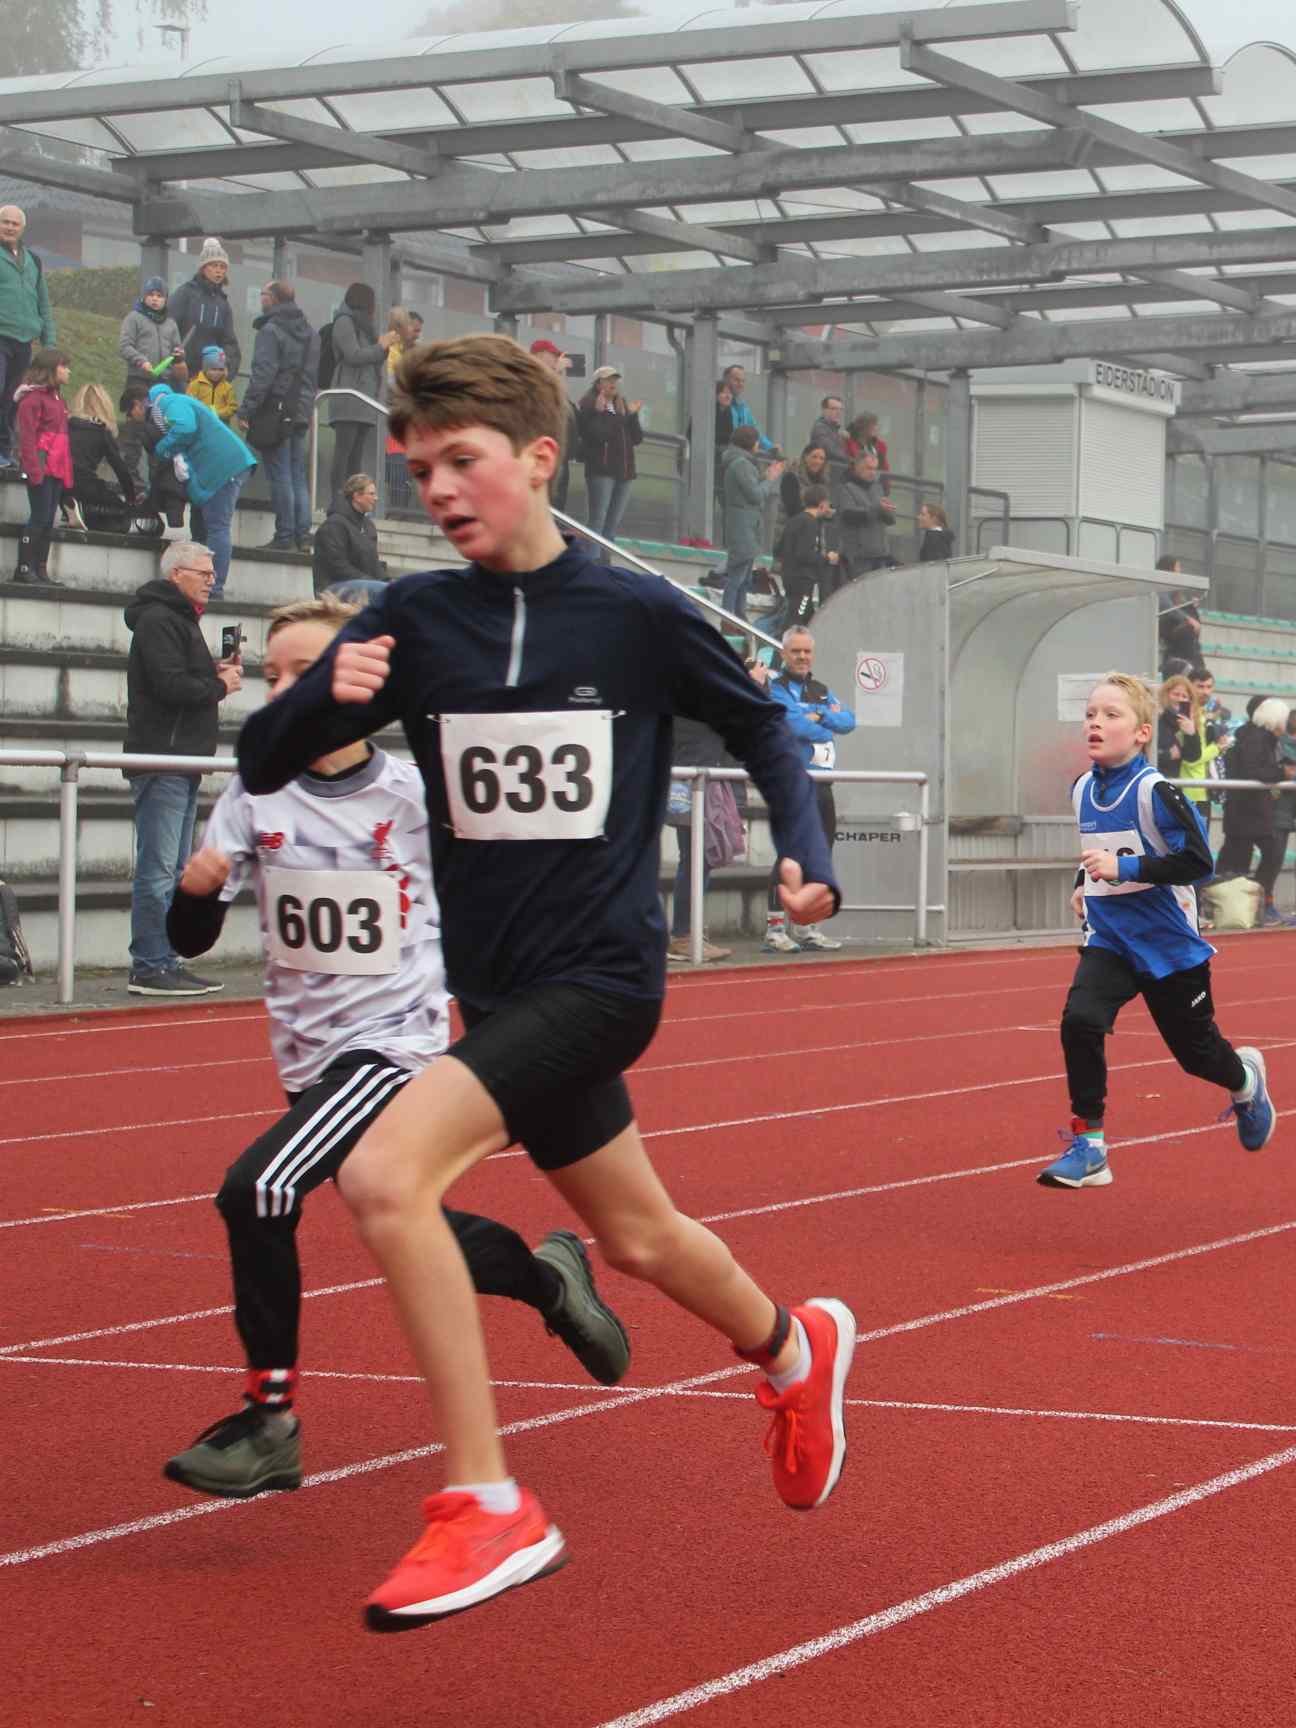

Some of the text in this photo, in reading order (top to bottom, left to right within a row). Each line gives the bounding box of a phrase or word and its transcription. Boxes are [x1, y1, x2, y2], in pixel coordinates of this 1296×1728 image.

[1096, 363, 1175, 402] EIDERSTADION
[459, 743, 593, 814] 633
[833, 832, 901, 842] CHAPER
[277, 894, 382, 954] 603
